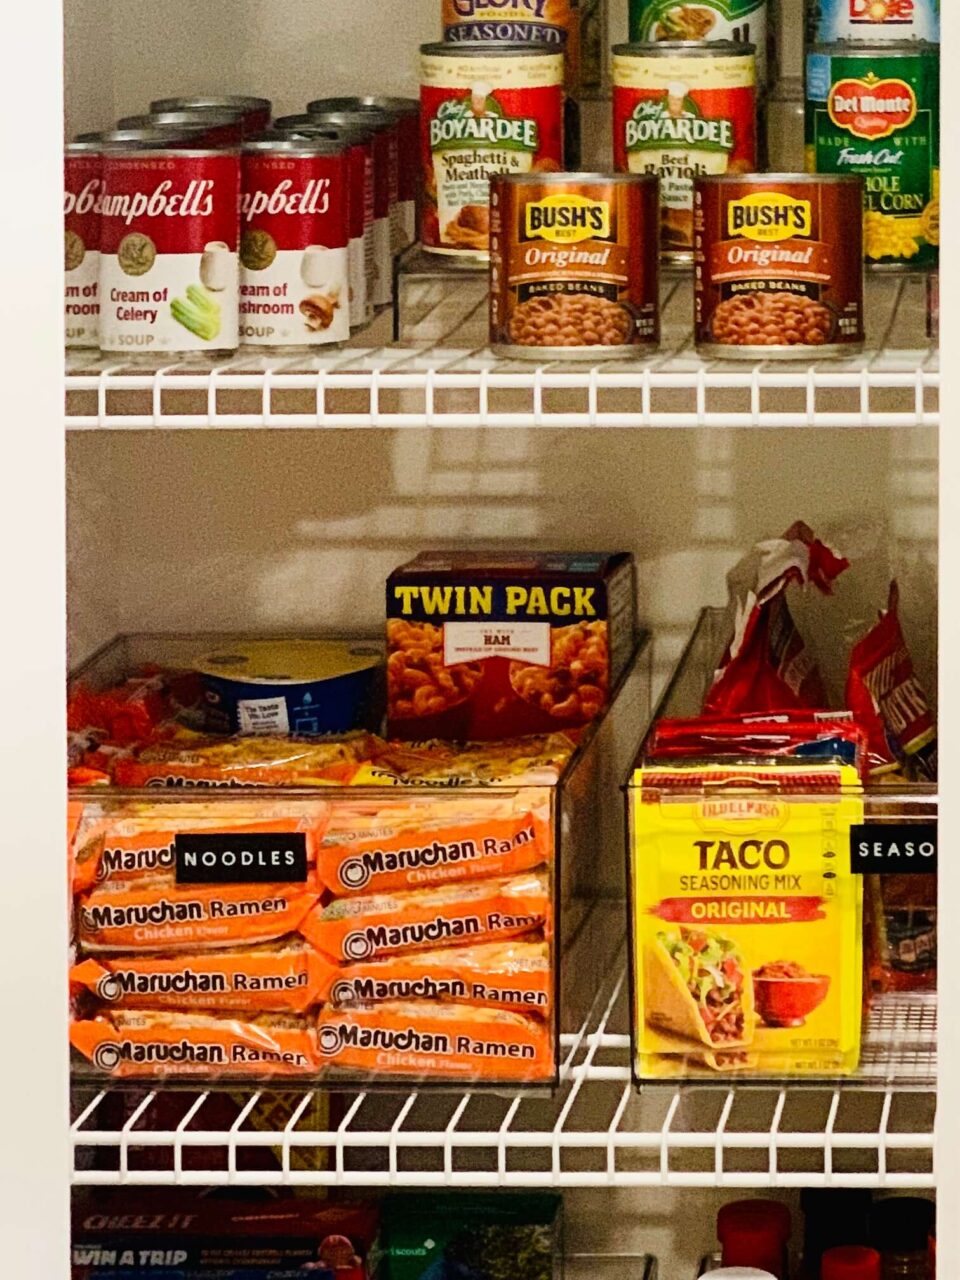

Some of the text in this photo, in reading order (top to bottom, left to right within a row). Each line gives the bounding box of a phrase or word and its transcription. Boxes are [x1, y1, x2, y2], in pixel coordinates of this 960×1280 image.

[449, 23, 562, 43] SEASONED
[437, 100, 467, 120] Chef
[633, 101, 662, 120] Chef
[834, 96, 910, 113] Del Monte
[430, 120, 537, 147] BOYARDEE
[625, 120, 733, 148] BOYARDEE
[441, 152, 520, 168] Spaghetti &
[661, 154, 688, 166] Beef
[880, 193, 923, 210] CORN
[530, 206, 603, 231] BUSH'S
[732, 205, 806, 230] BUSH'S
[525, 246, 611, 268] Original
[727, 246, 812, 266] Original
[82, 283, 98, 298] of
[110, 288, 168, 302] Cream of
[273, 283, 288, 297] of
[528, 283, 605, 293] BAKED BEANS
[731, 282, 807, 292] BAKED BEANS
[116, 307, 158, 324] Celery
[118, 335, 155, 346] SOUP
[394, 586, 597, 616] TWIN PACK
[483, 635, 511, 646] HAM
[184, 850, 295, 867] NOODLES
[362, 840, 475, 872] Maruchan
[693, 839, 790, 871] TACO
[406, 867, 467, 883] Chicken
[680, 874, 802, 891] SEASONING MIX
[92, 897, 287, 927] Maruchan Ramen
[691, 901, 792, 919] ORIGINAL
[134, 925, 193, 941] Chicken
[366, 917, 479, 947] Maruchan
[117, 970, 308, 993] Maruchan Ramen
[353, 977, 548, 1005] Maruchan Ramen
[158, 995, 215, 1005] Chicken
[339, 1024, 535, 1059] Maruchan Ramen
[120, 1041, 223, 1063] Maruchan
[377, 1053, 437, 1068] Chicken
[72, 1250, 116, 1266] WIN
[119, 1250, 134, 1266] A
[138, 1250, 188, 1266] TRIP
